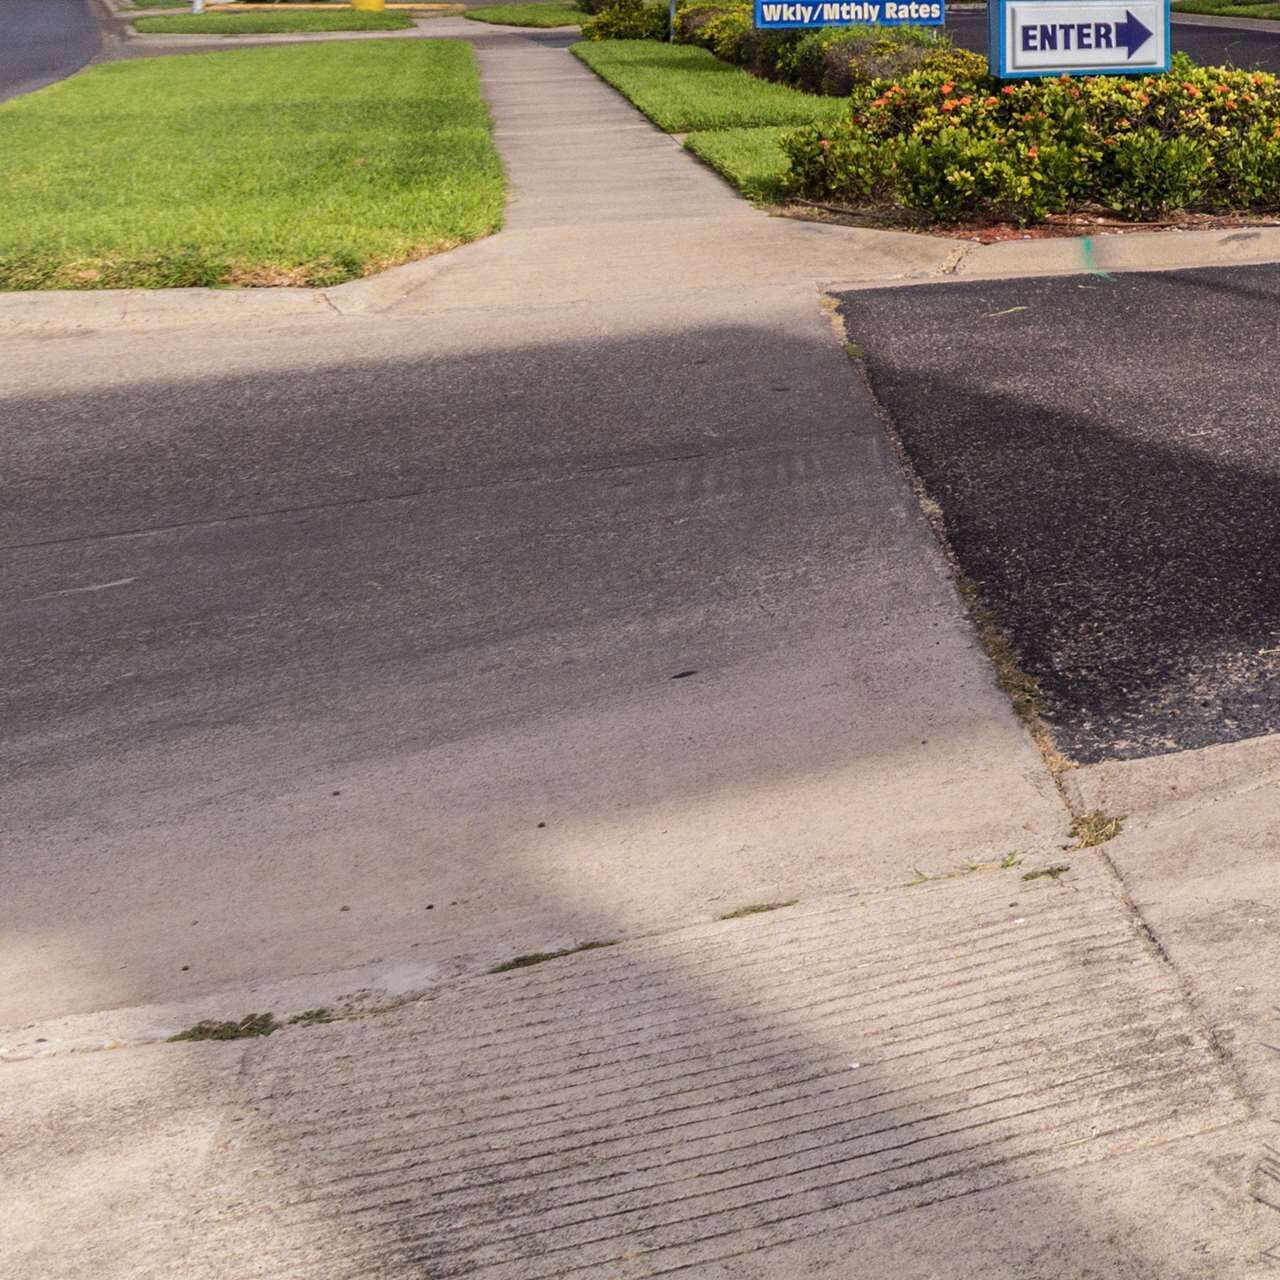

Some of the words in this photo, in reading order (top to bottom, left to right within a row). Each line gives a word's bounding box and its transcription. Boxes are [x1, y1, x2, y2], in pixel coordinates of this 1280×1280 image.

[762, 1, 880, 23] Wkly/Mthly
[885, 1, 941, 19] Rates
[1021, 22, 1113, 52] ENTER
